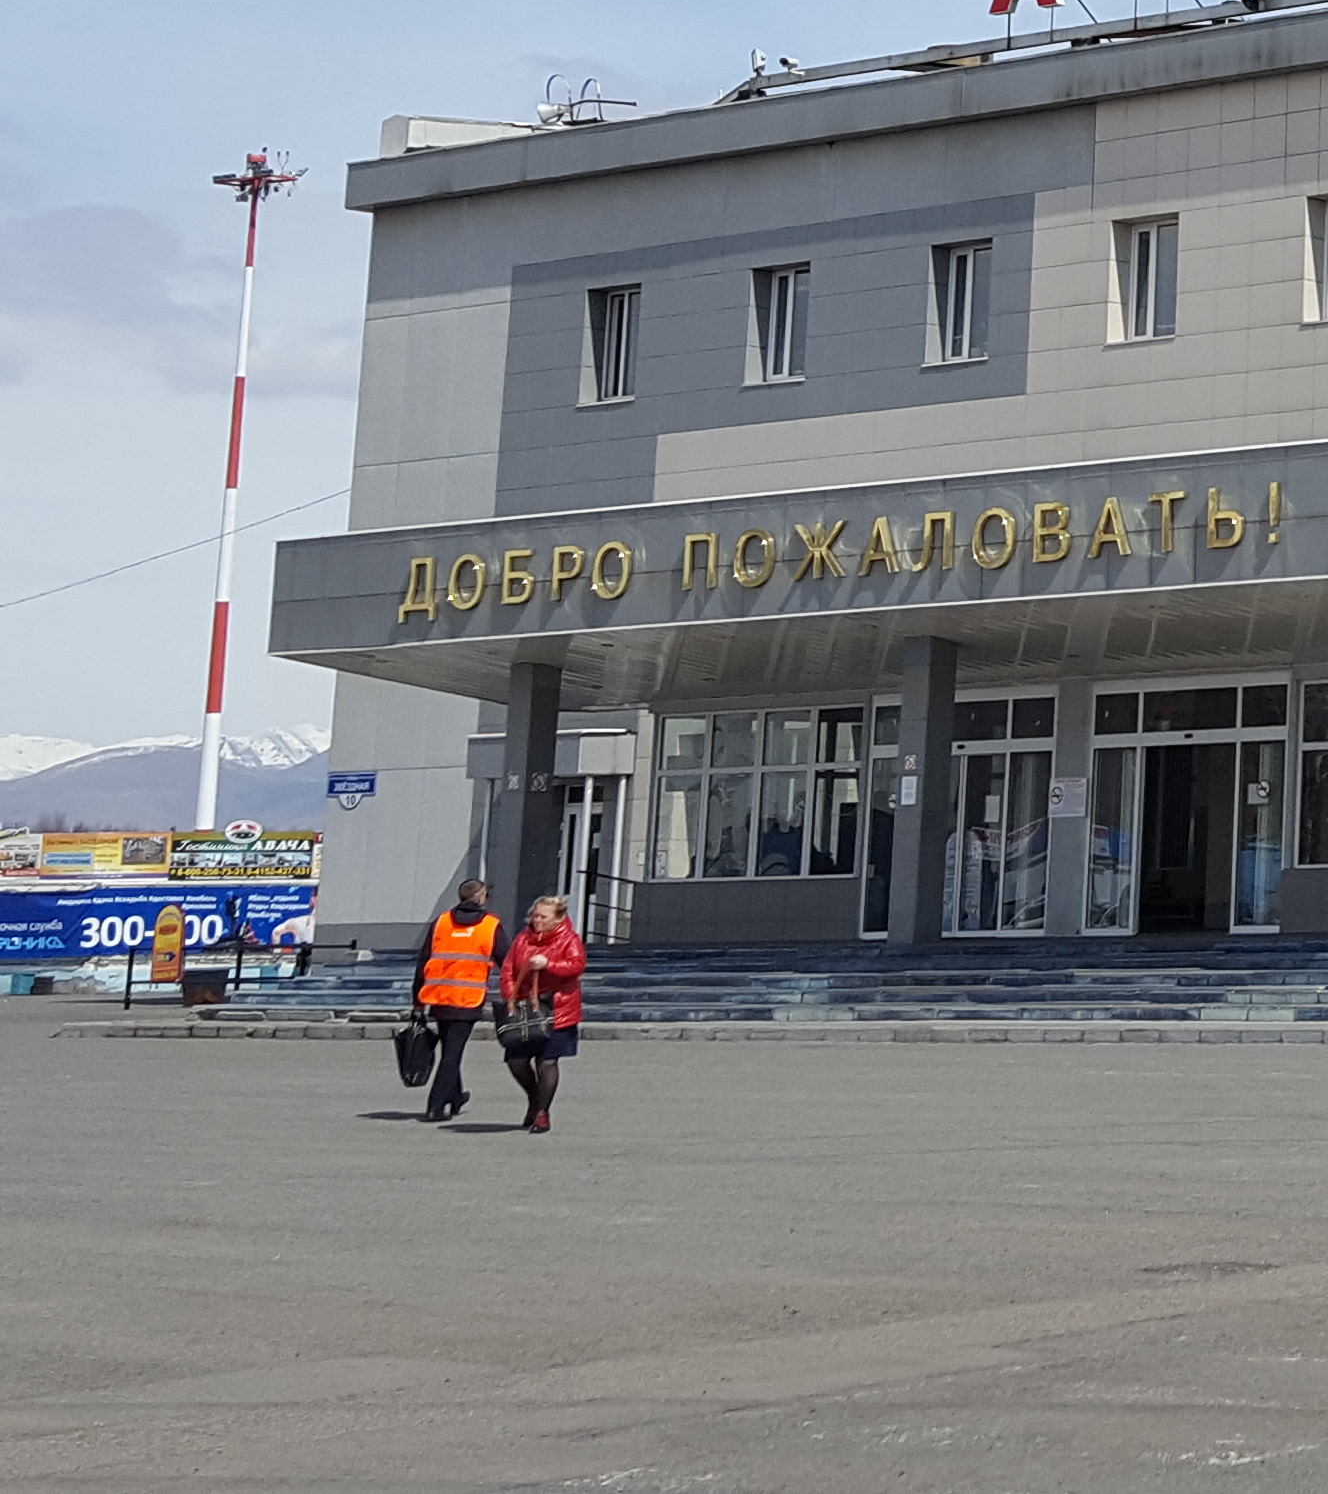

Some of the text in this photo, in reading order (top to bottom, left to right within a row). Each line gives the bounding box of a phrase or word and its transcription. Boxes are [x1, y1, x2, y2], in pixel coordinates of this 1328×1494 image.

[397, 480, 1284, 624] ДОБРО ПОЖАЛОВАТЬ!
[345, 795, 356, 806] 10
[251, 840, 310, 851] АВАЧА
